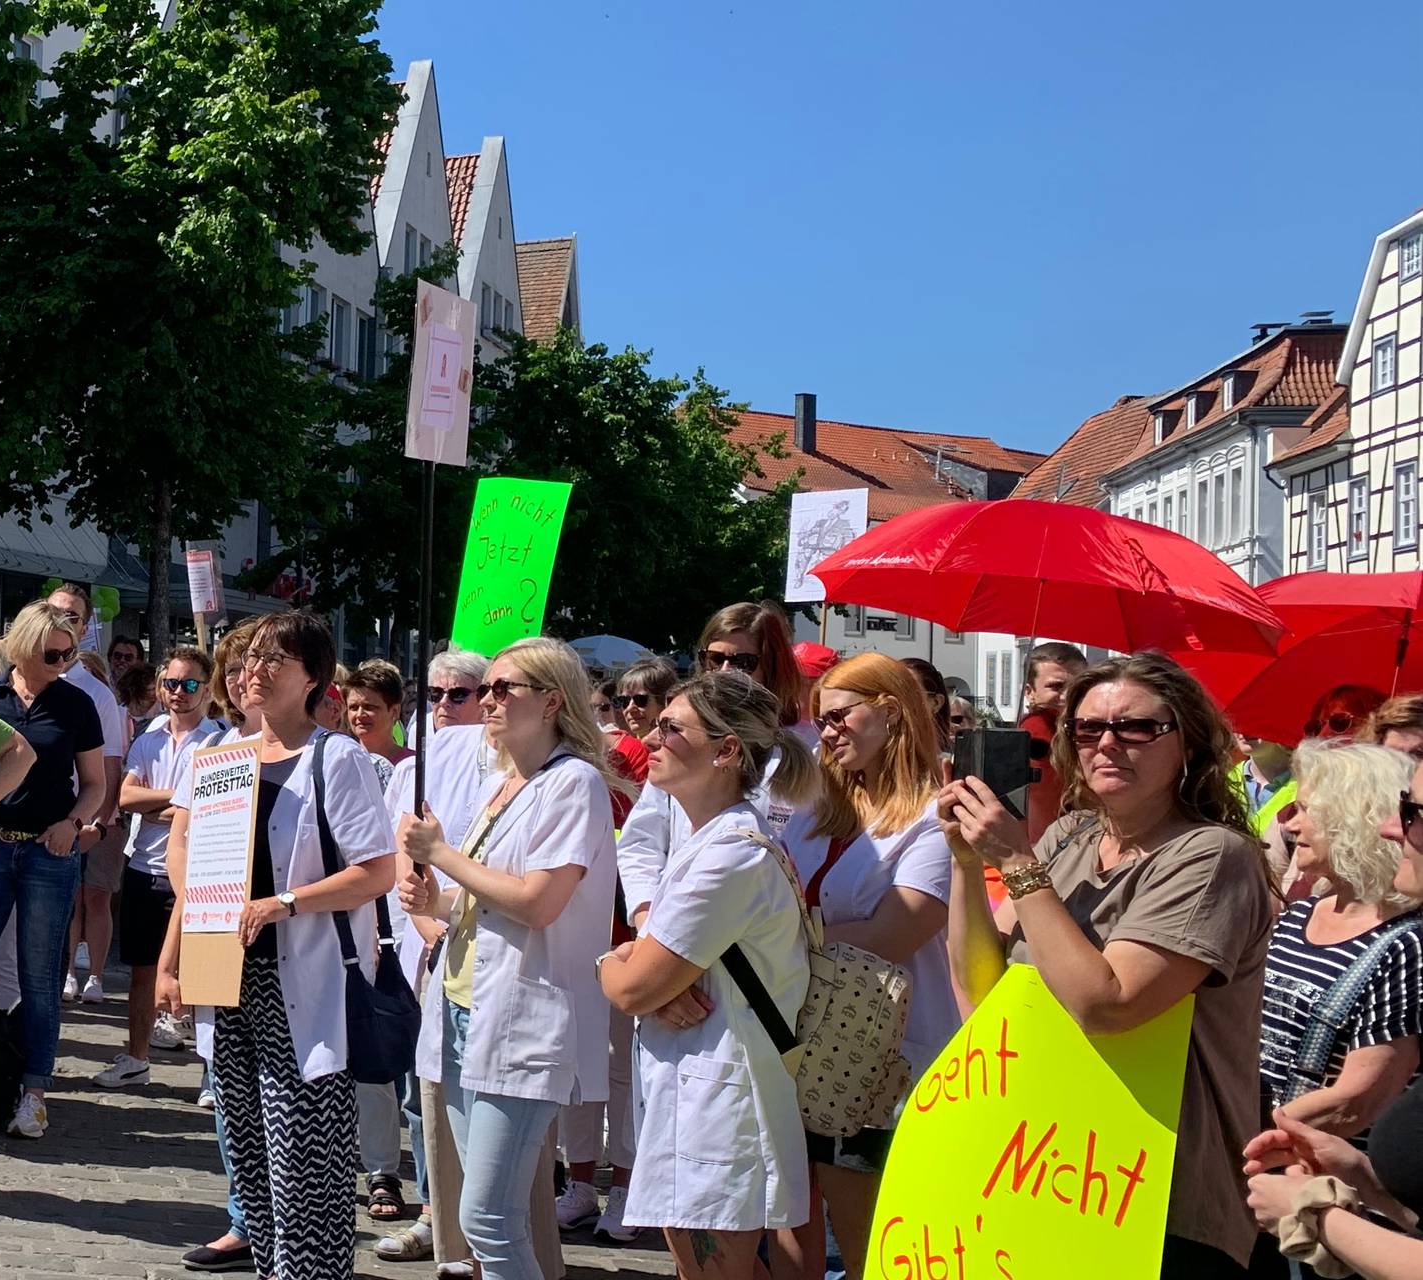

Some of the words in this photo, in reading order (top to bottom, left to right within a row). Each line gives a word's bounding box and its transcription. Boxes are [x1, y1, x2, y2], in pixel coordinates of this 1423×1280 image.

[510, 494, 557, 527] nicht
[477, 533, 534, 569] Jetzt
[483, 603, 513, 626] dann
[193, 773, 254, 800] PROTESTTAG
[200, 763, 250, 785] BUNDESWEITER
[982, 1119, 1148, 1228] Nicht
